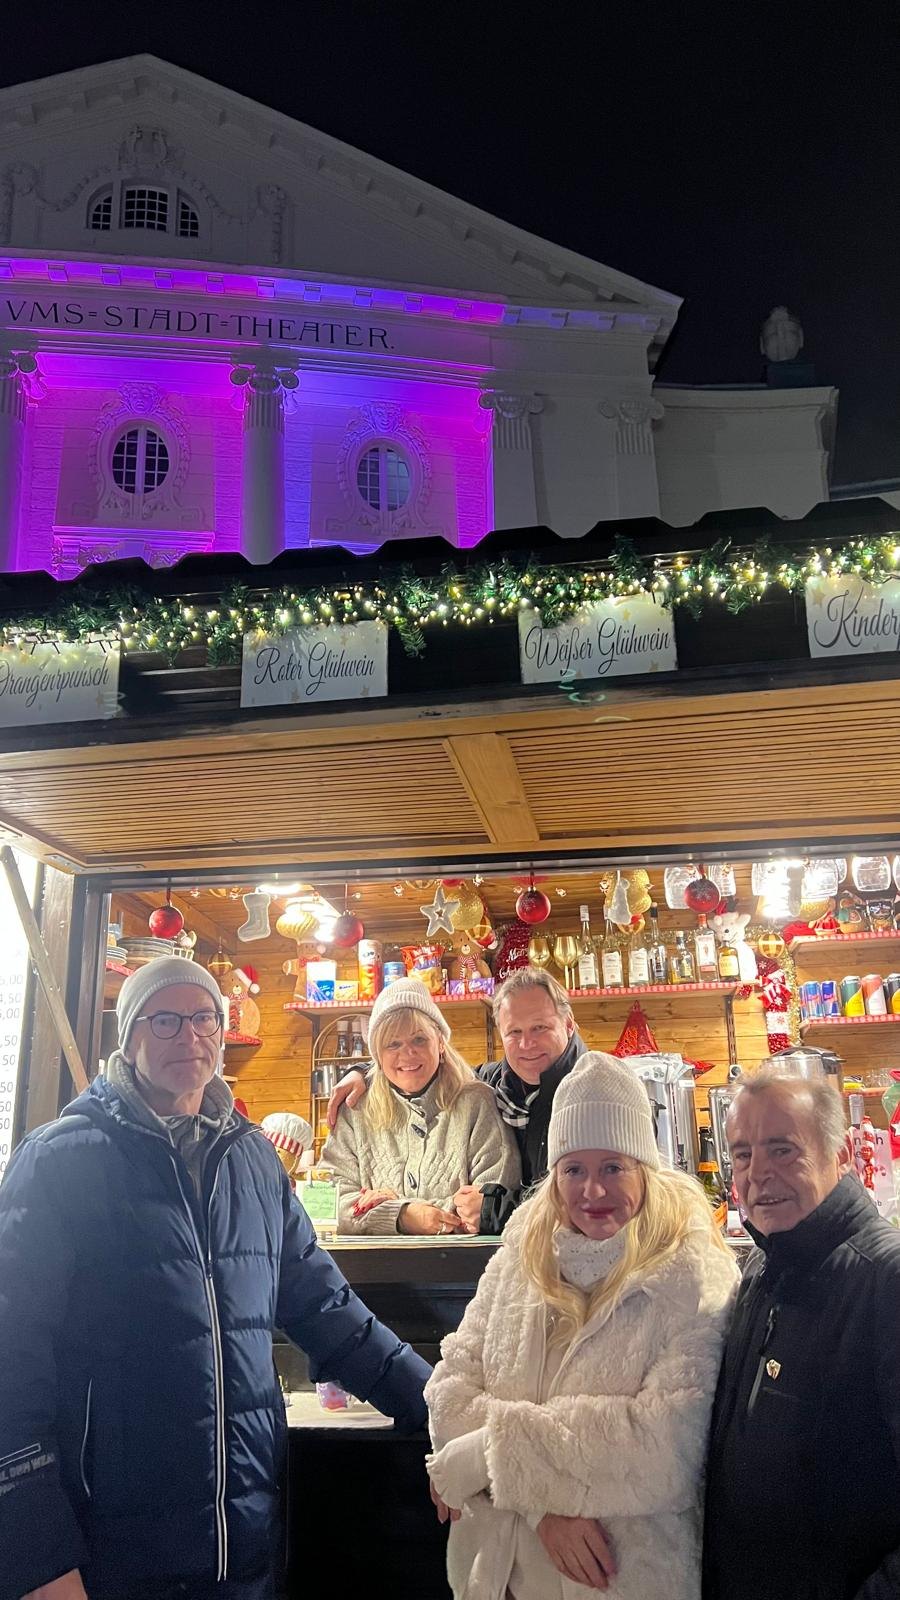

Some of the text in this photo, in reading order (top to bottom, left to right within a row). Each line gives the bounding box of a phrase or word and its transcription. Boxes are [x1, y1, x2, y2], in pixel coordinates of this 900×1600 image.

[525, 617, 670, 676] Weißer Glühwein
[813, 585, 900, 651] Kinder
[254, 641, 375, 695] Roter Glühwein
